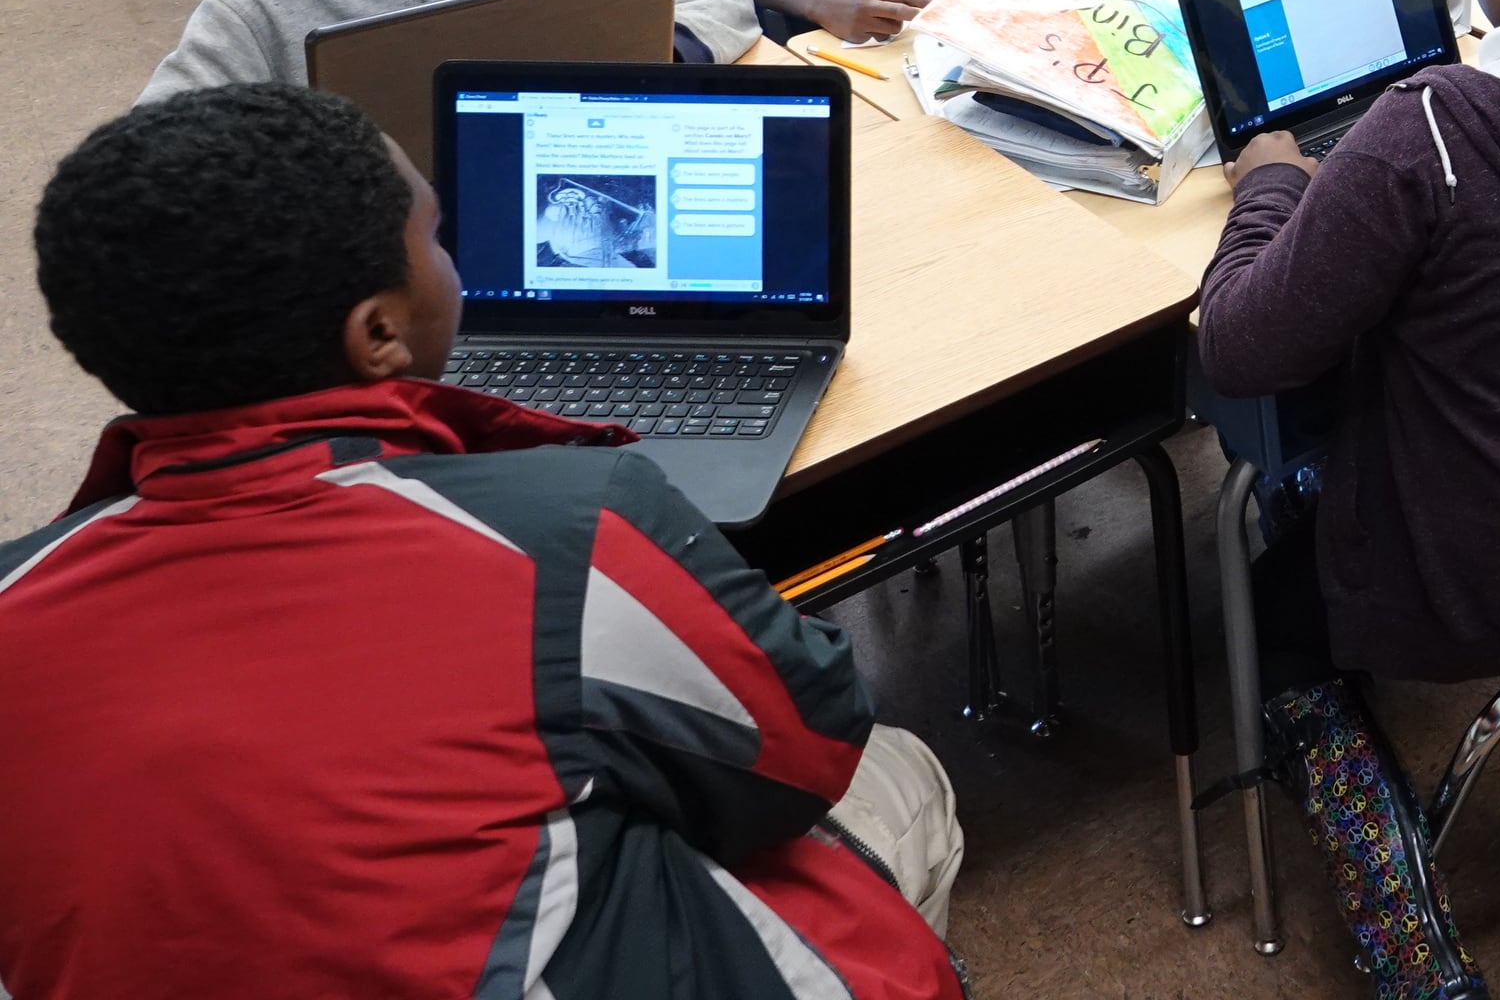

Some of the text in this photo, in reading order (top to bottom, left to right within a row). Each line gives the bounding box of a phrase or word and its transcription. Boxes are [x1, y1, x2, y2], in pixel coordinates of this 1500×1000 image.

[1092, 2, 1167, 59] Bin
[1336, 93, 1354, 105] DELL
[629, 305, 656, 316] DELL
